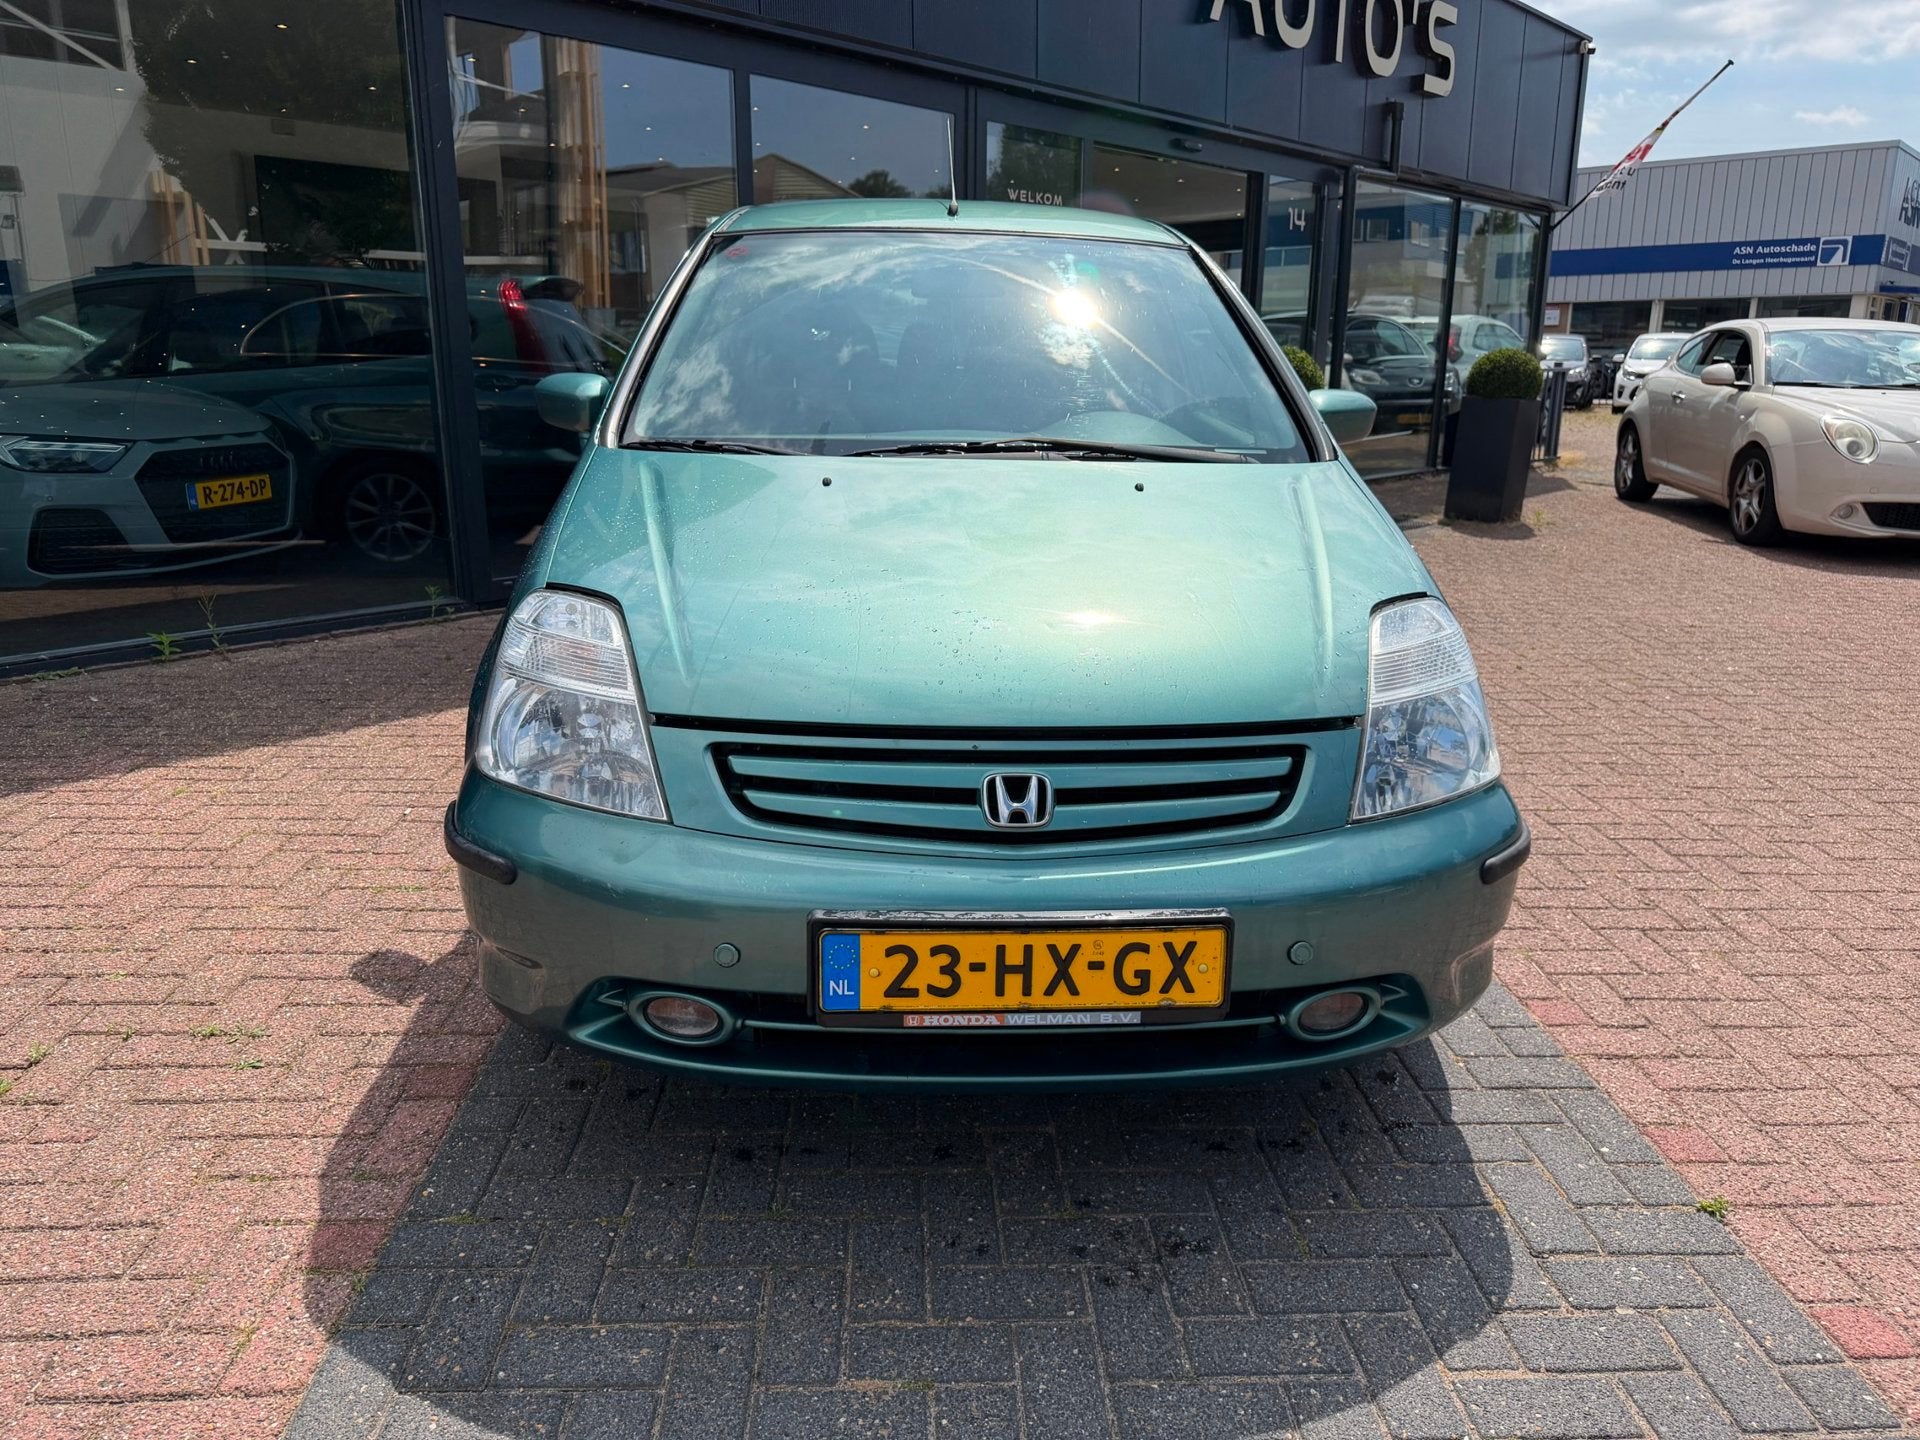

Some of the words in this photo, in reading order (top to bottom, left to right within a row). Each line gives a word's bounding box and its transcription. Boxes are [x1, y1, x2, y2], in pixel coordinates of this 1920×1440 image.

[1007, 188, 1063, 206] WELKOM
[1288, 207, 1306, 232] 14
[1733, 246, 1754, 255] ASN
[1756, 243, 1817, 254] Autoschade
[202, 478, 267, 505] R-274-DP
[829, 979, 855, 996] NL
[883, 940, 1198, 998] 23-HX-GX
[923, 1014, 1001, 1026] HONDA
[1007, 1012, 1091, 1025] WELMAN
[1100, 1012, 1138, 1024] B.V.
